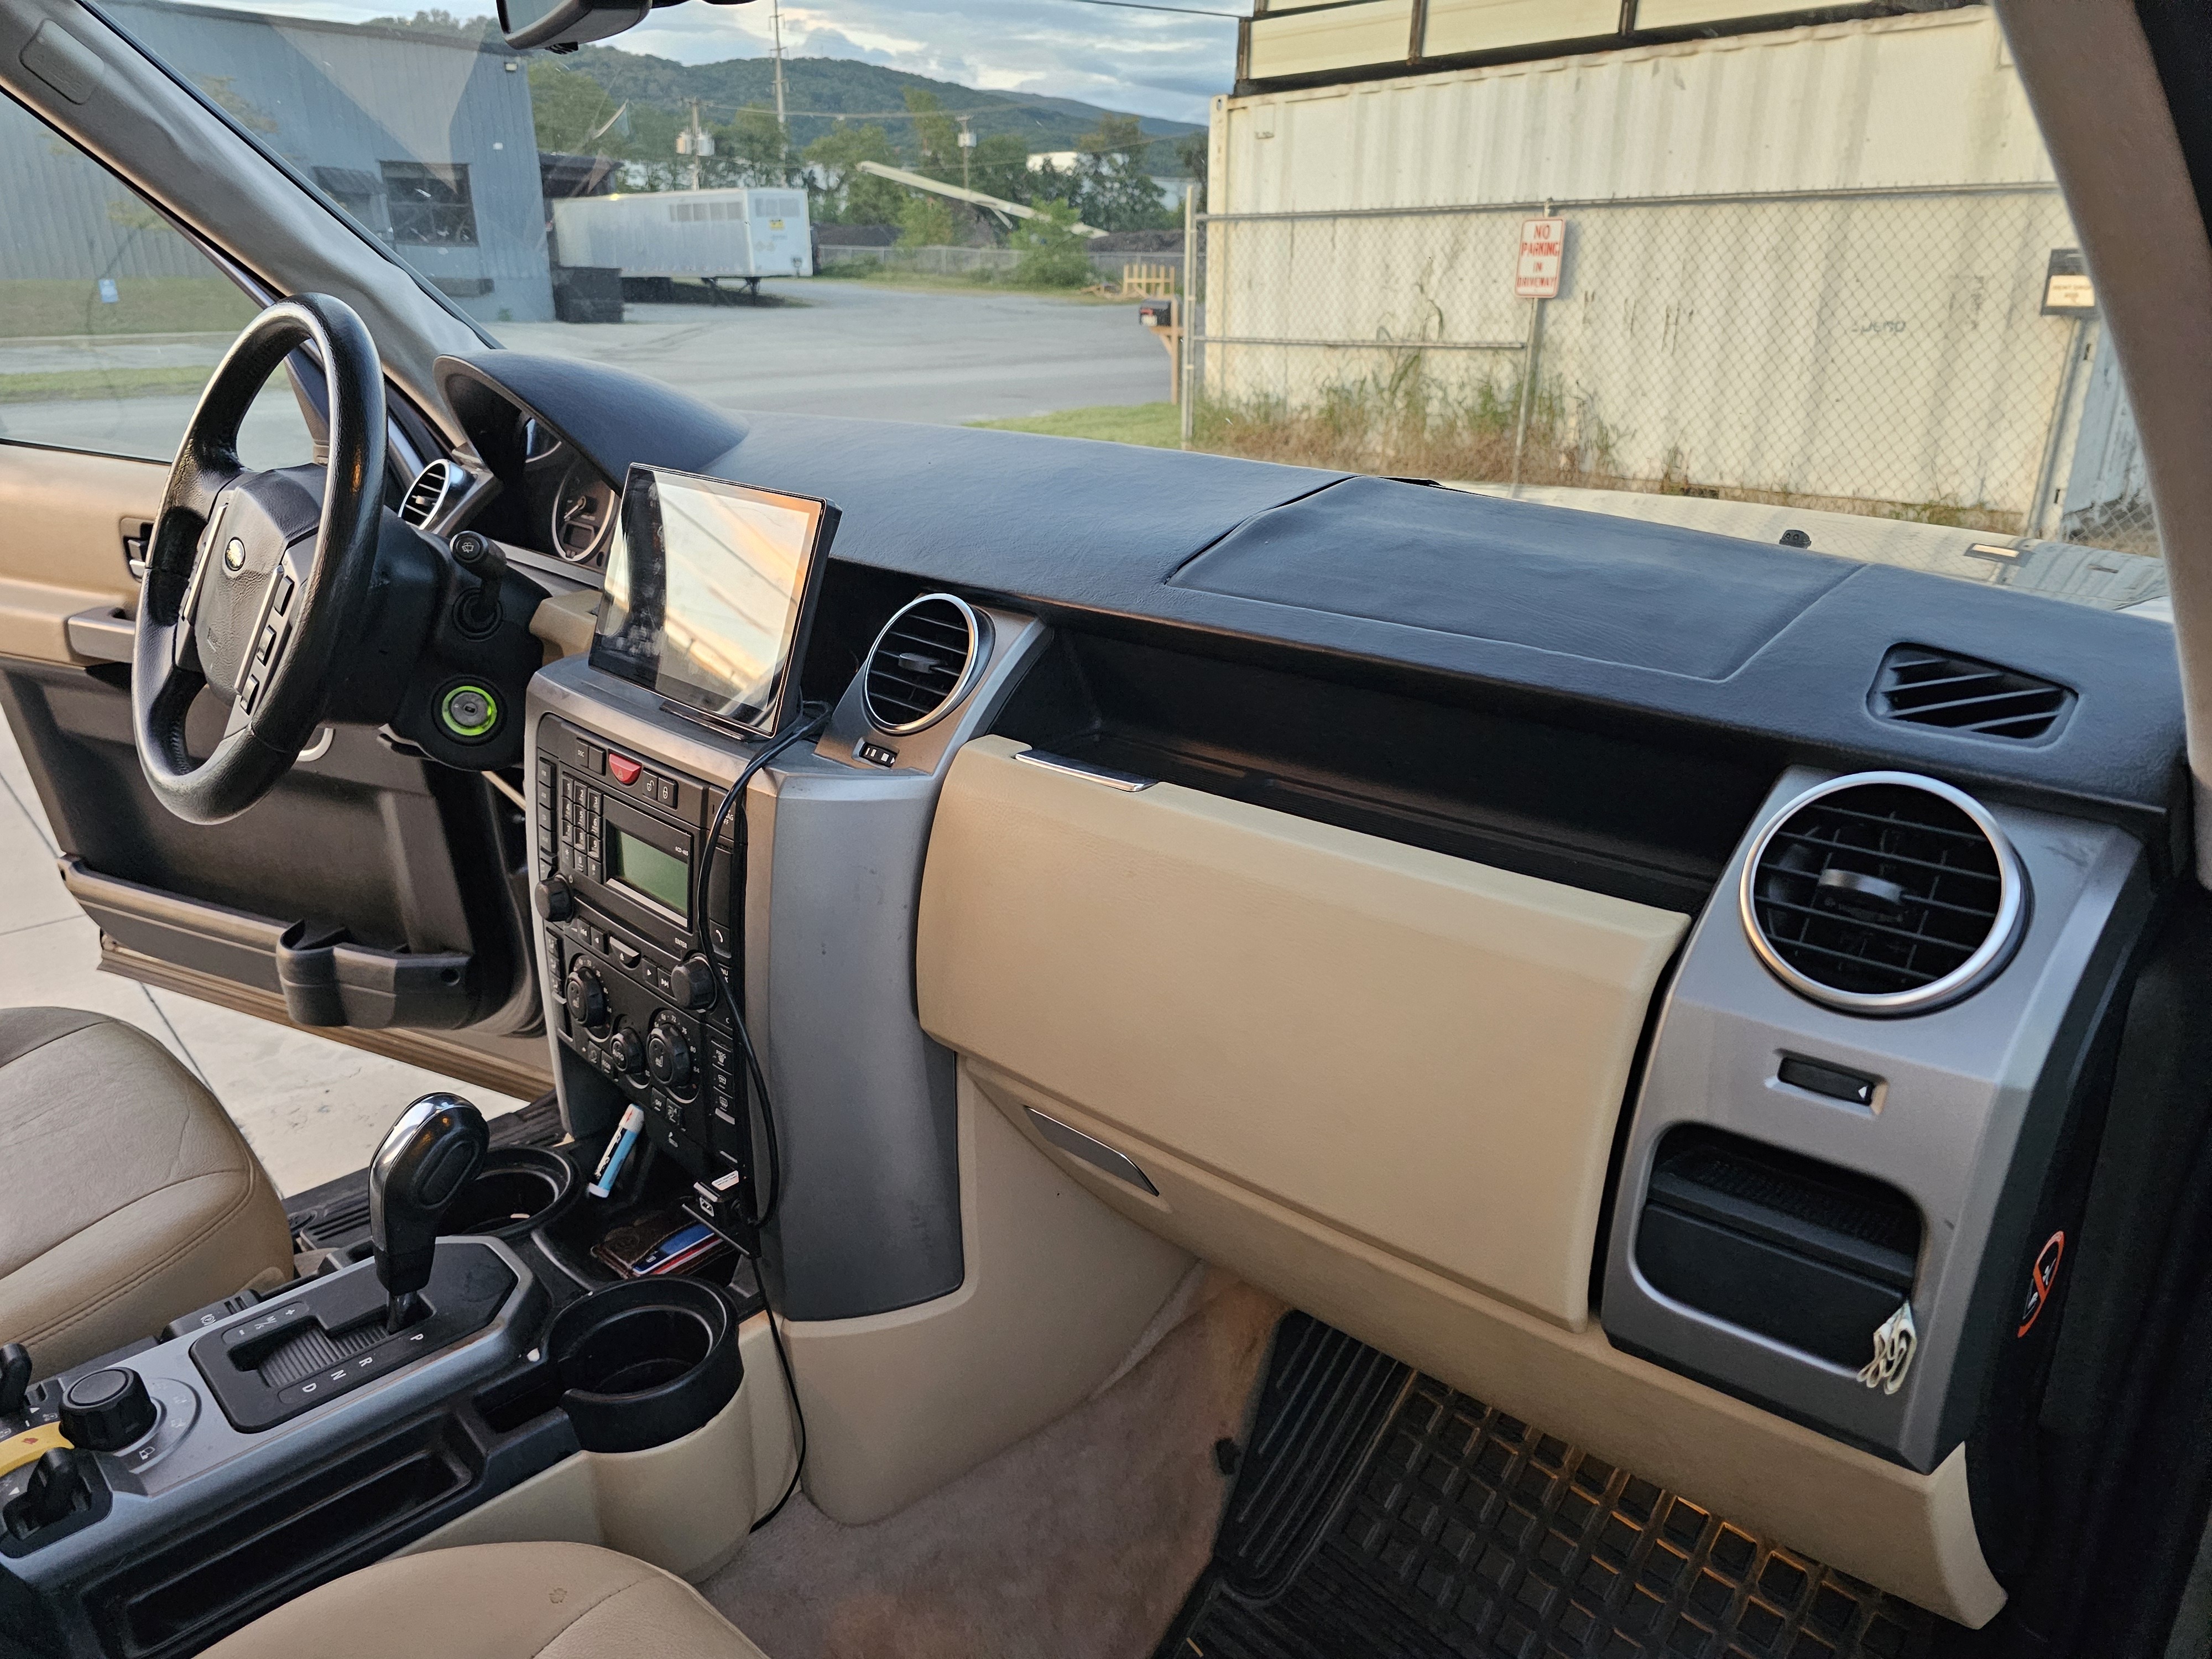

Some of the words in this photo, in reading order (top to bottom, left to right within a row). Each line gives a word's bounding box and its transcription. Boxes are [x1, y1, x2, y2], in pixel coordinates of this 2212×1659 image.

[1534, 225, 1551, 239] NO
[1521, 242, 1559, 257] PARKING
[1533, 262, 1542, 273] IN
[1517, 277, 1557, 287] DRIVEWAY
[675, 937, 687, 950] ENTER
[410, 1333, 424, 1341] P
[359, 1357, 373, 1367] R
[331, 1369, 346, 1380] N
[302, 1383, 317, 1393] D
